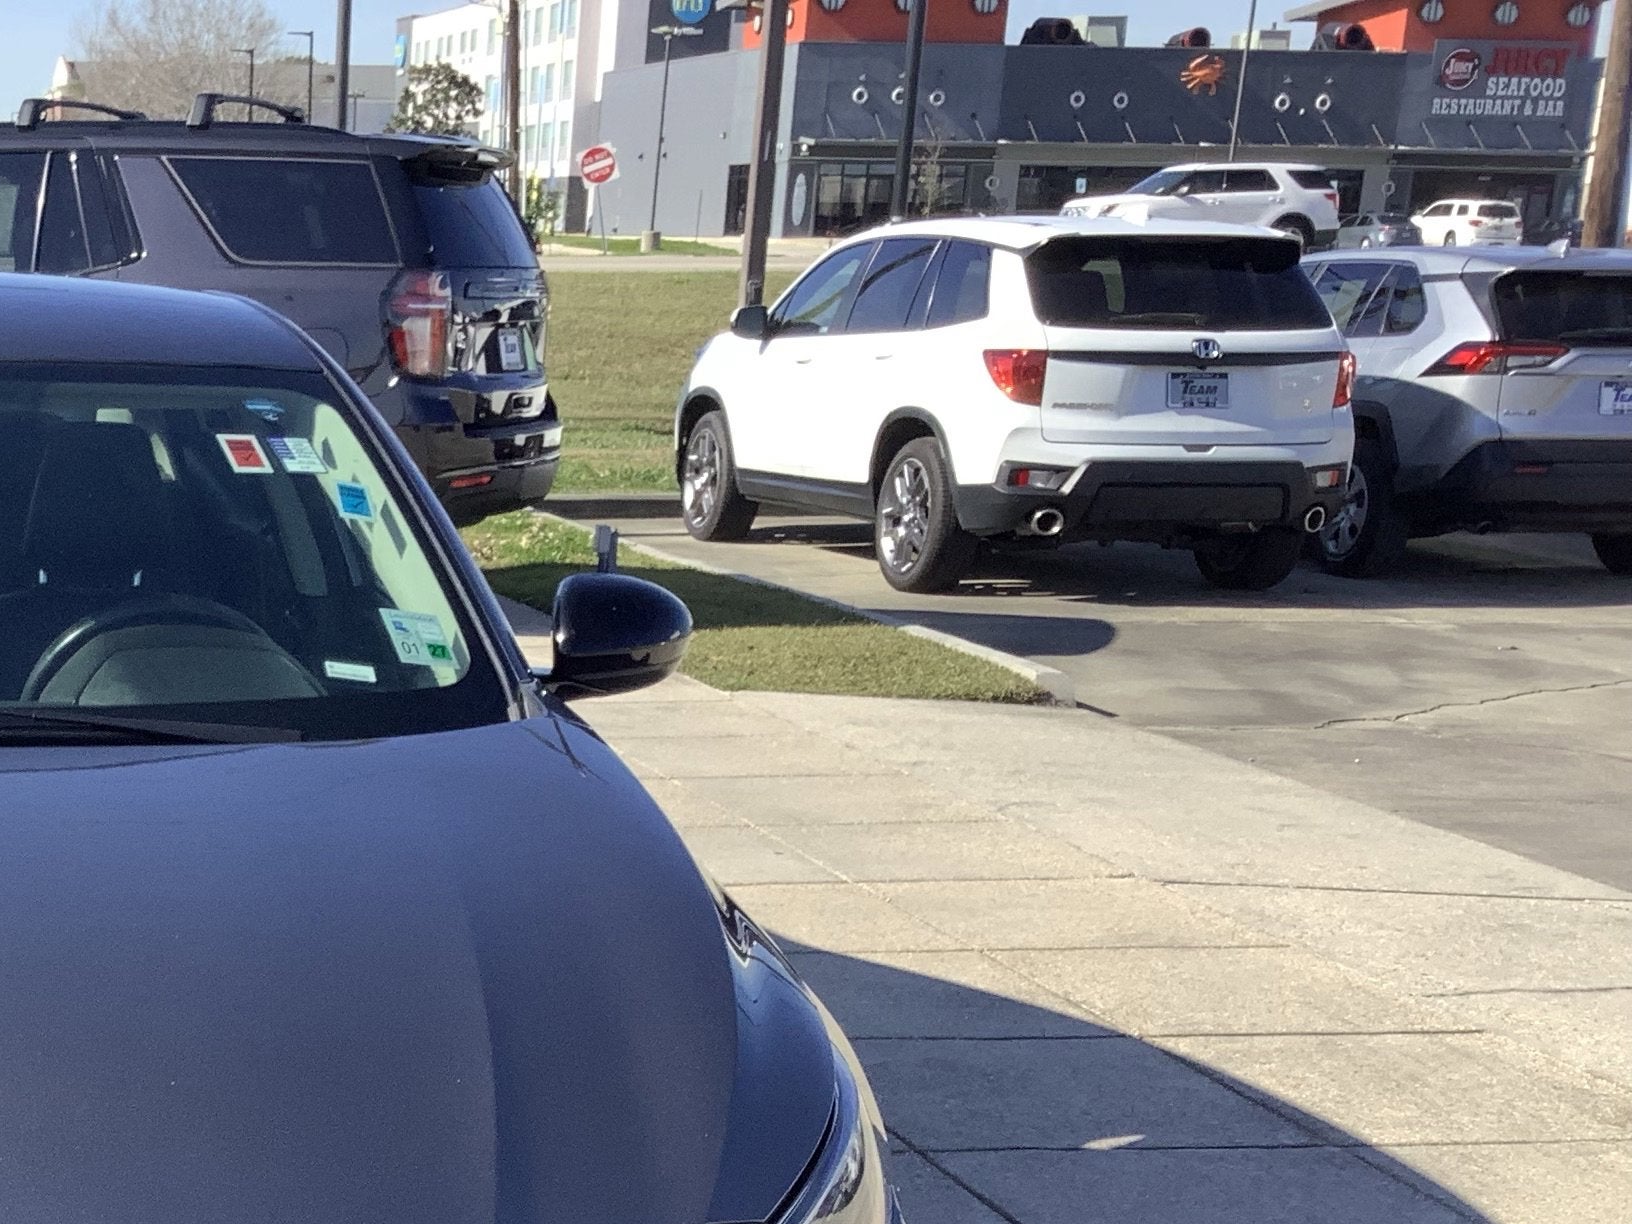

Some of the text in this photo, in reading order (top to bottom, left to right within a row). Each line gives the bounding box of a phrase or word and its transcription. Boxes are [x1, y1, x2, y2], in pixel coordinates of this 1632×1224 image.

[1485, 48, 1570, 75] JUICY
[1485, 77, 1567, 97] SEAFOOD
[1431, 97, 1565, 117] RESTAURANT & BAR
[1181, 379, 1218, 395] TEAM
[401, 641, 420, 657] 01
